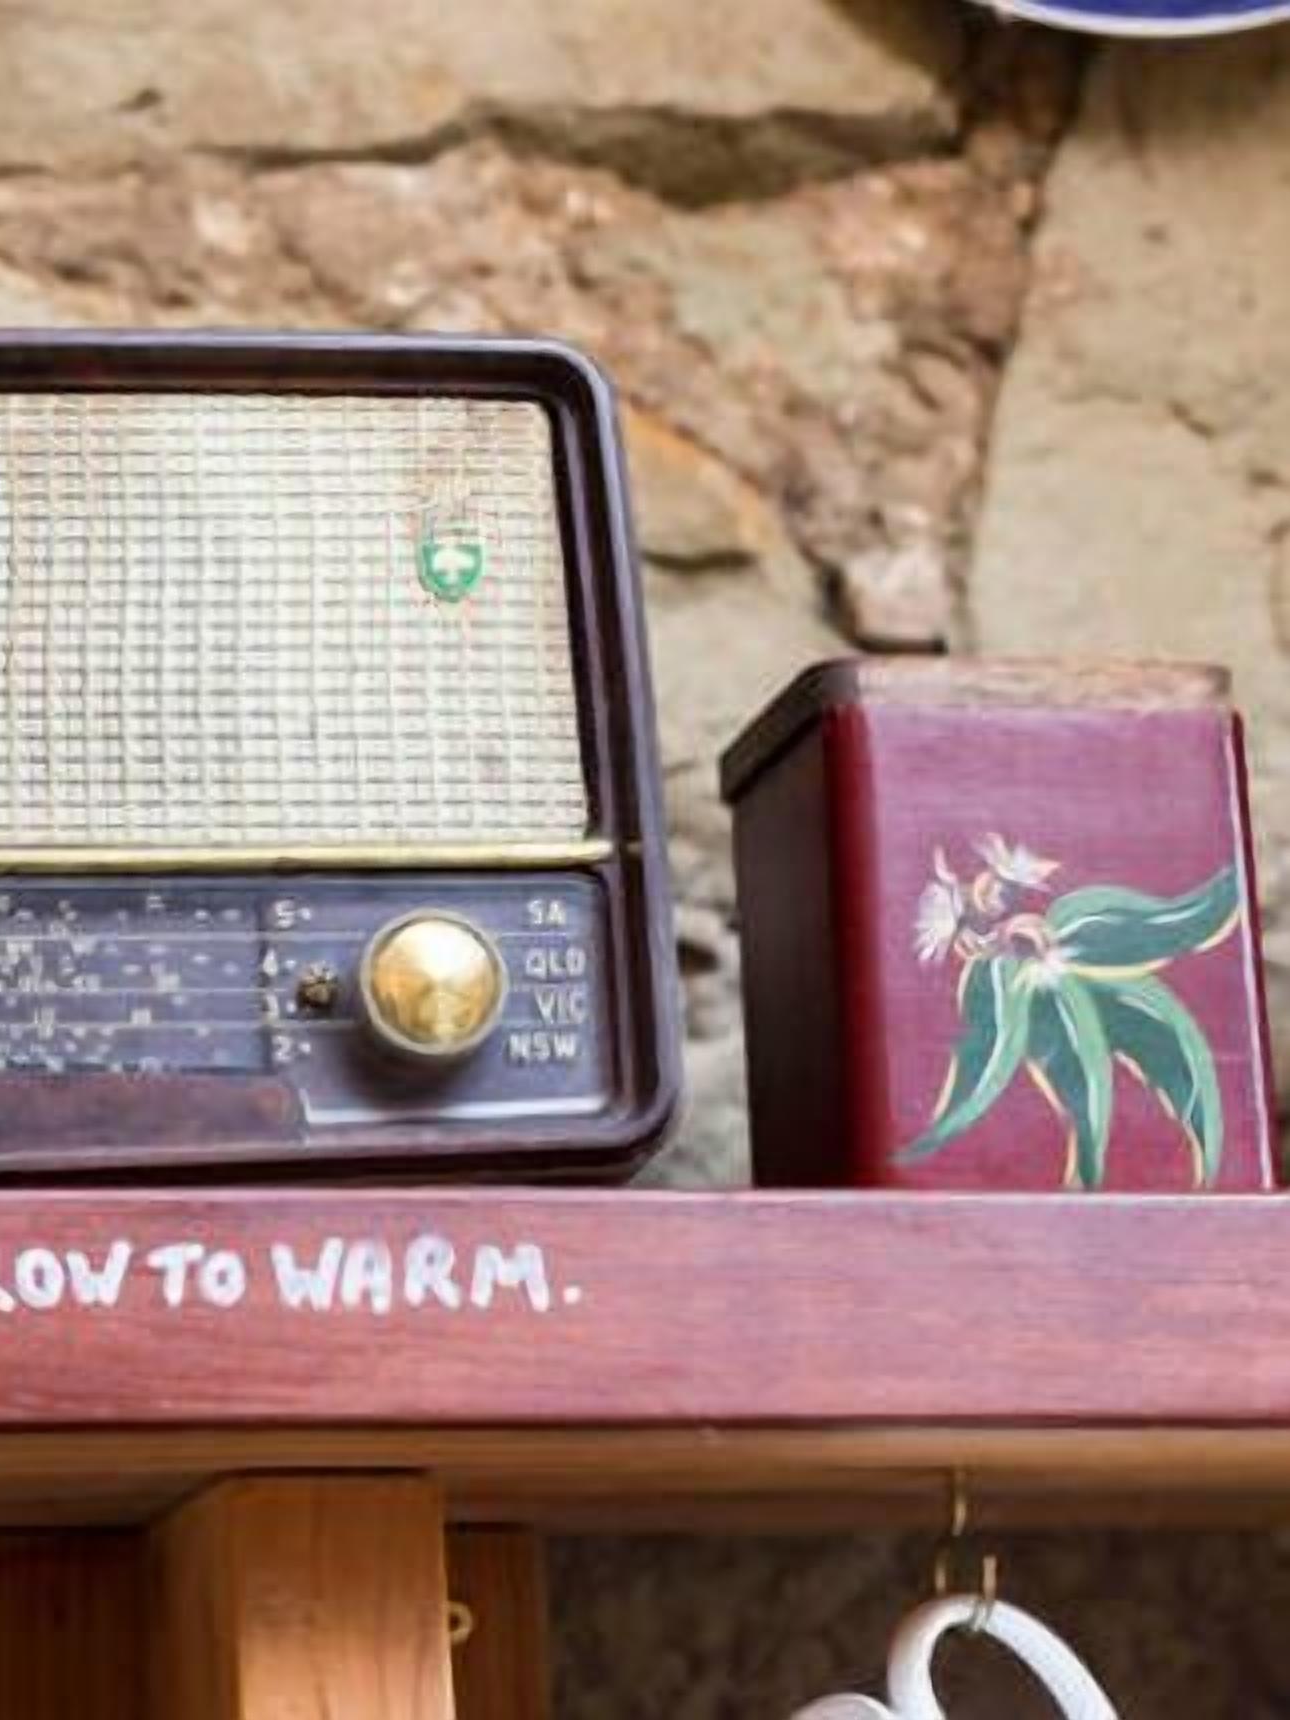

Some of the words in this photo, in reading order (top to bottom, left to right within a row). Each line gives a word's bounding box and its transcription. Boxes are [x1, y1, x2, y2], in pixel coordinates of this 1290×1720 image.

[527, 899, 566, 925] SA
[534, 987, 586, 1024] VIC
[272, 1034, 293, 1063] 2
[510, 1030, 577, 1060] NSW
[147, 1242, 247, 1309] TO
[270, 1234, 583, 1314] WARM.
